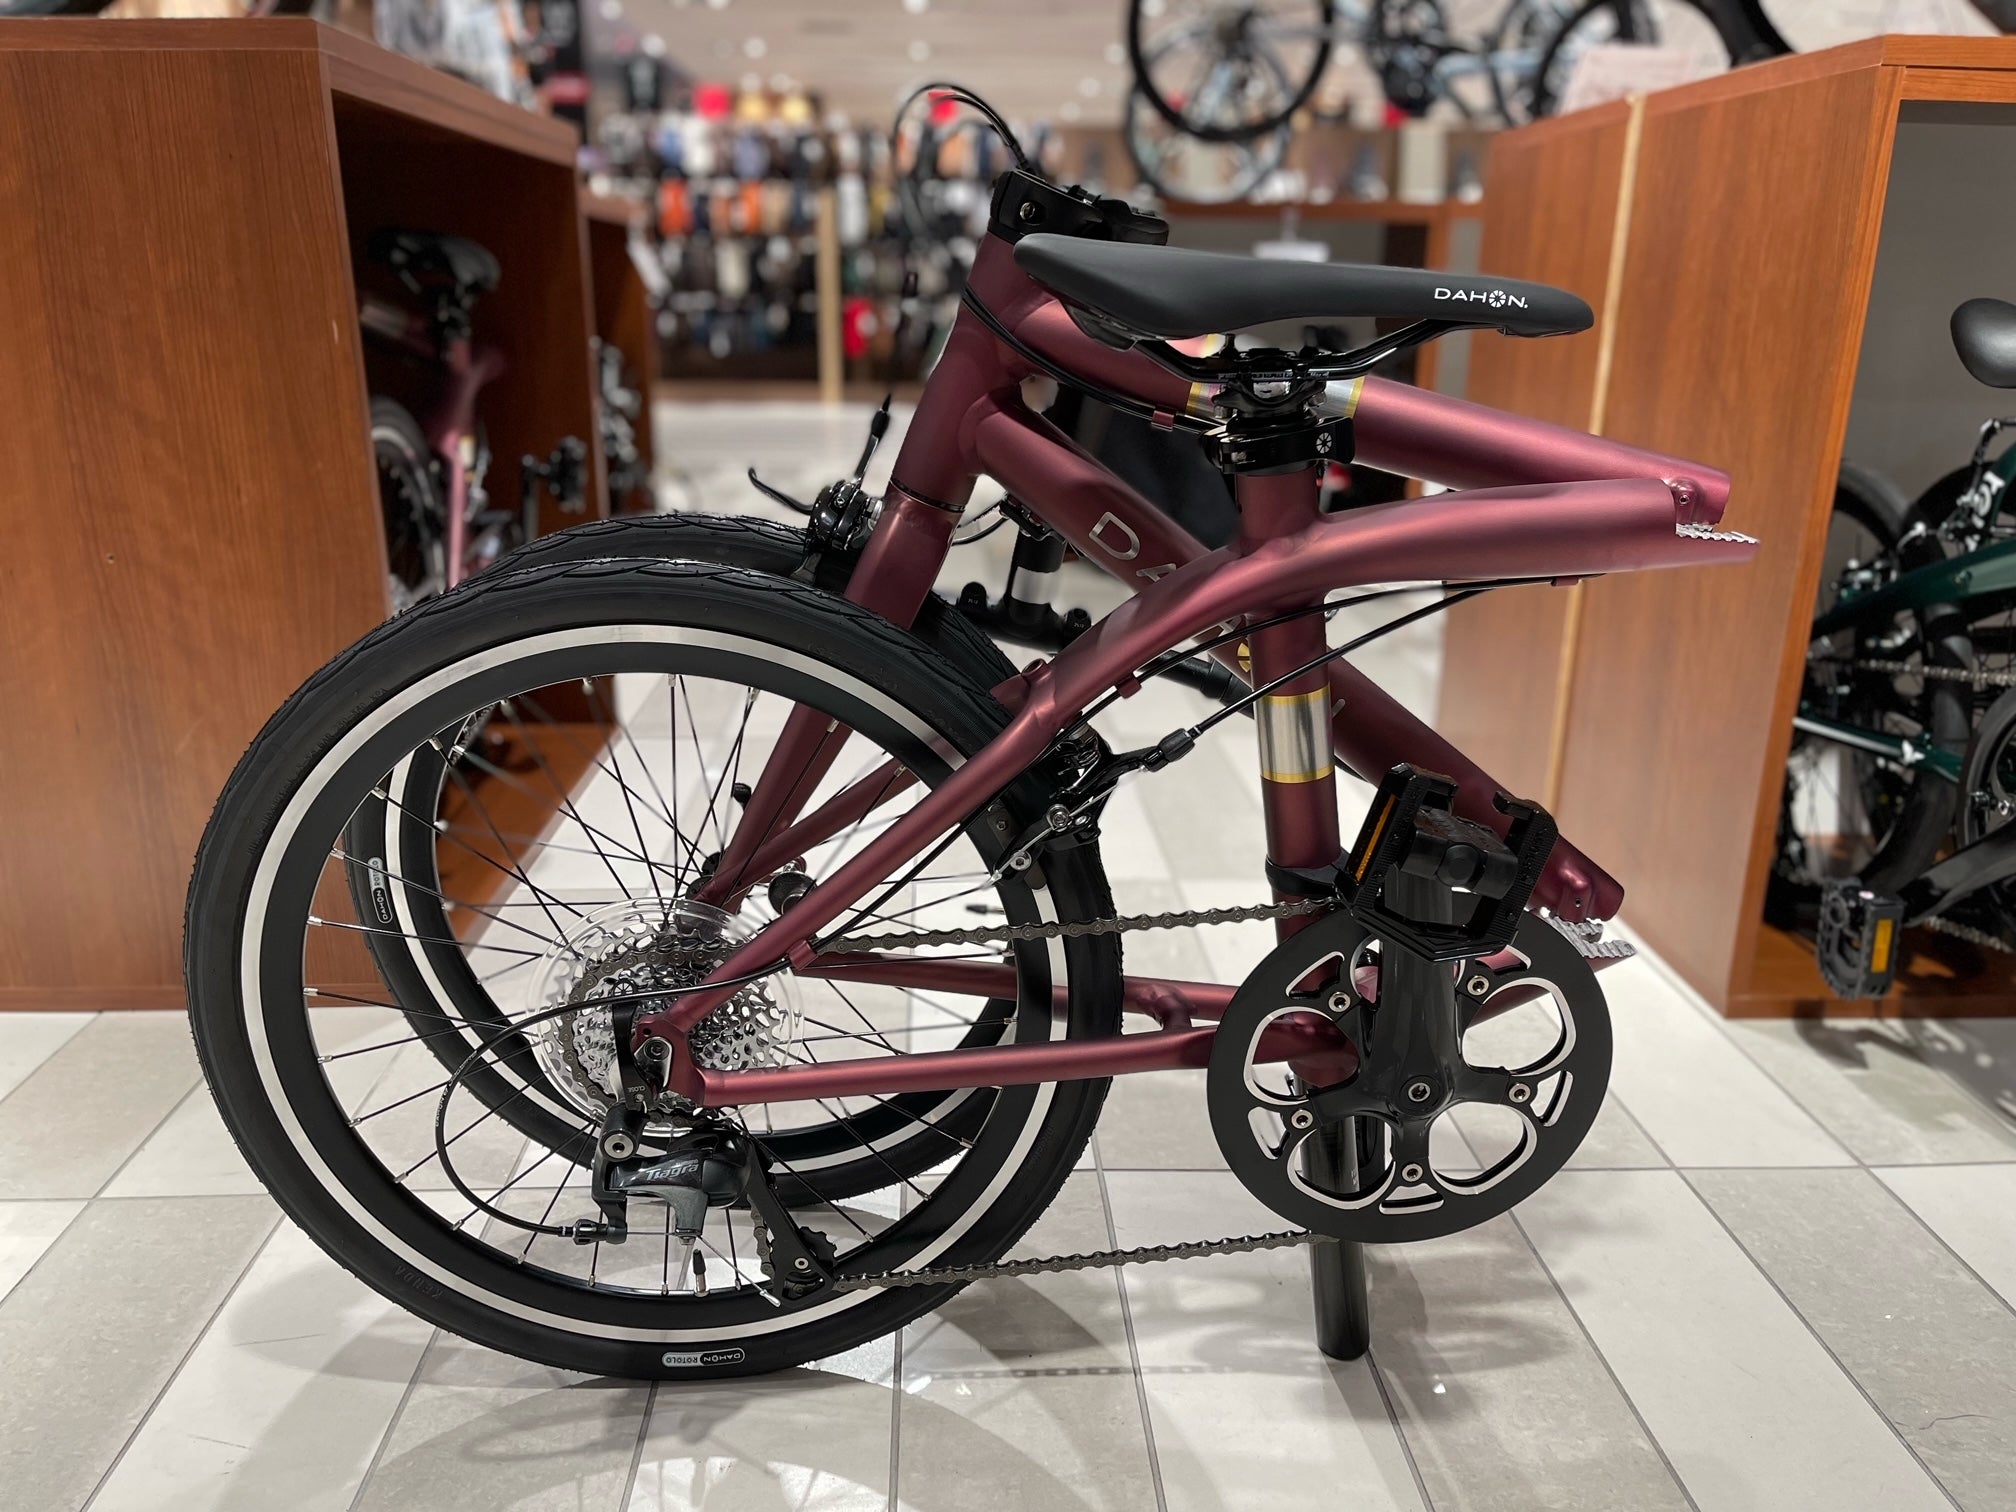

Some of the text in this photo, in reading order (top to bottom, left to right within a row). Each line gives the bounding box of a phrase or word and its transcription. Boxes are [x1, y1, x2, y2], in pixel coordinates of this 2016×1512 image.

[376, 890, 388, 920] DAHON
[645, 1163, 700, 1181] Tiagra
[666, 1352, 741, 1364] DAHON ROTOLO
